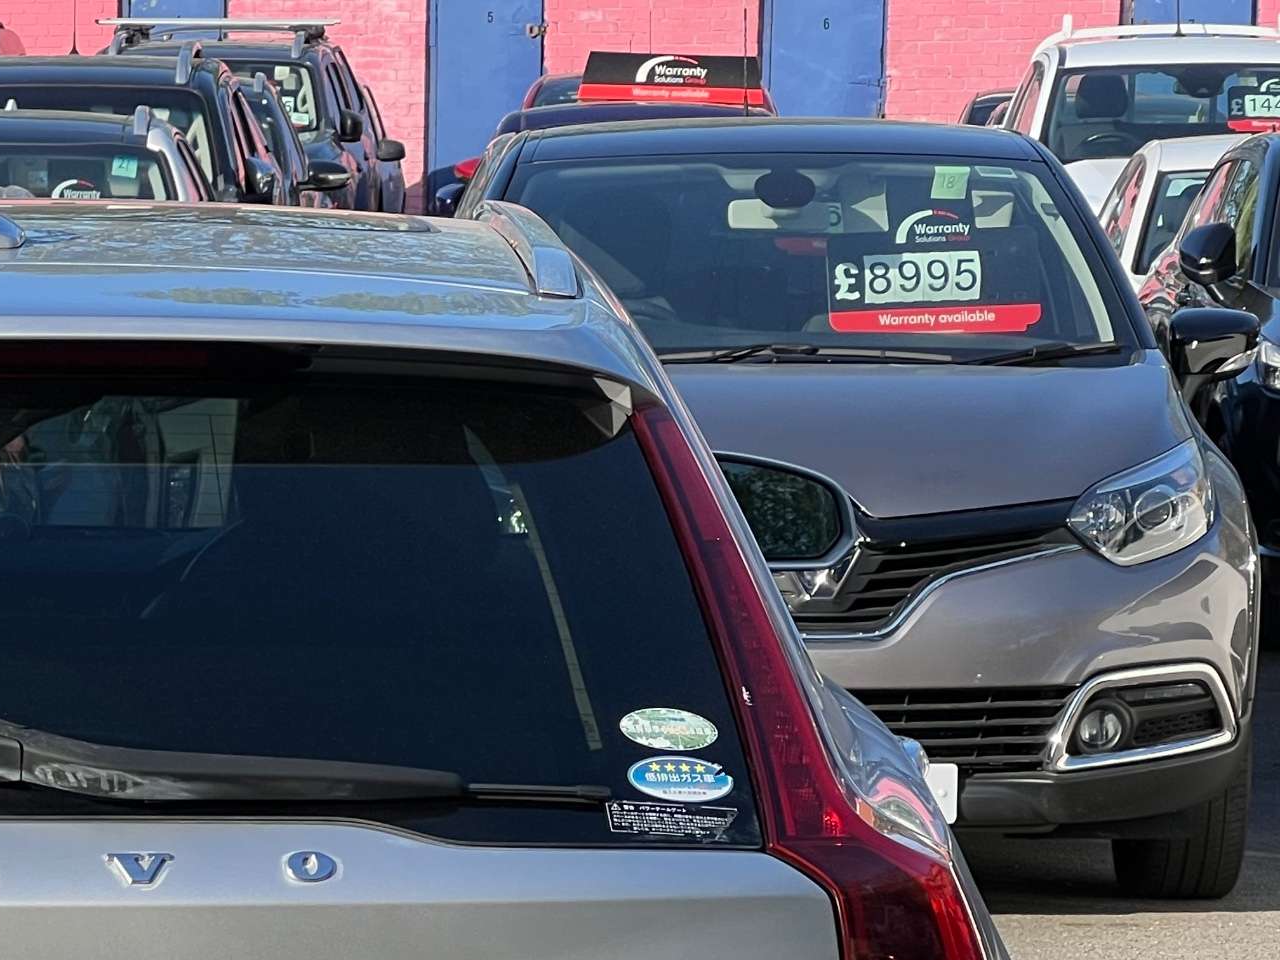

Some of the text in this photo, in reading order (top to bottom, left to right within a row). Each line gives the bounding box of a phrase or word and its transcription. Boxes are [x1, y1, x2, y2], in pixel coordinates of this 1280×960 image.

[487, 11, 494, 23] 5
[823, 17, 830, 30] 6
[654, 64, 708, 79] Warranty
[63, 188, 101, 199] Warranty
[913, 222, 971, 236] Warranty
[914, 235, 947, 243] Solutions
[834, 258, 978, 300] £8995
[879, 310, 996, 327] Warranty available
